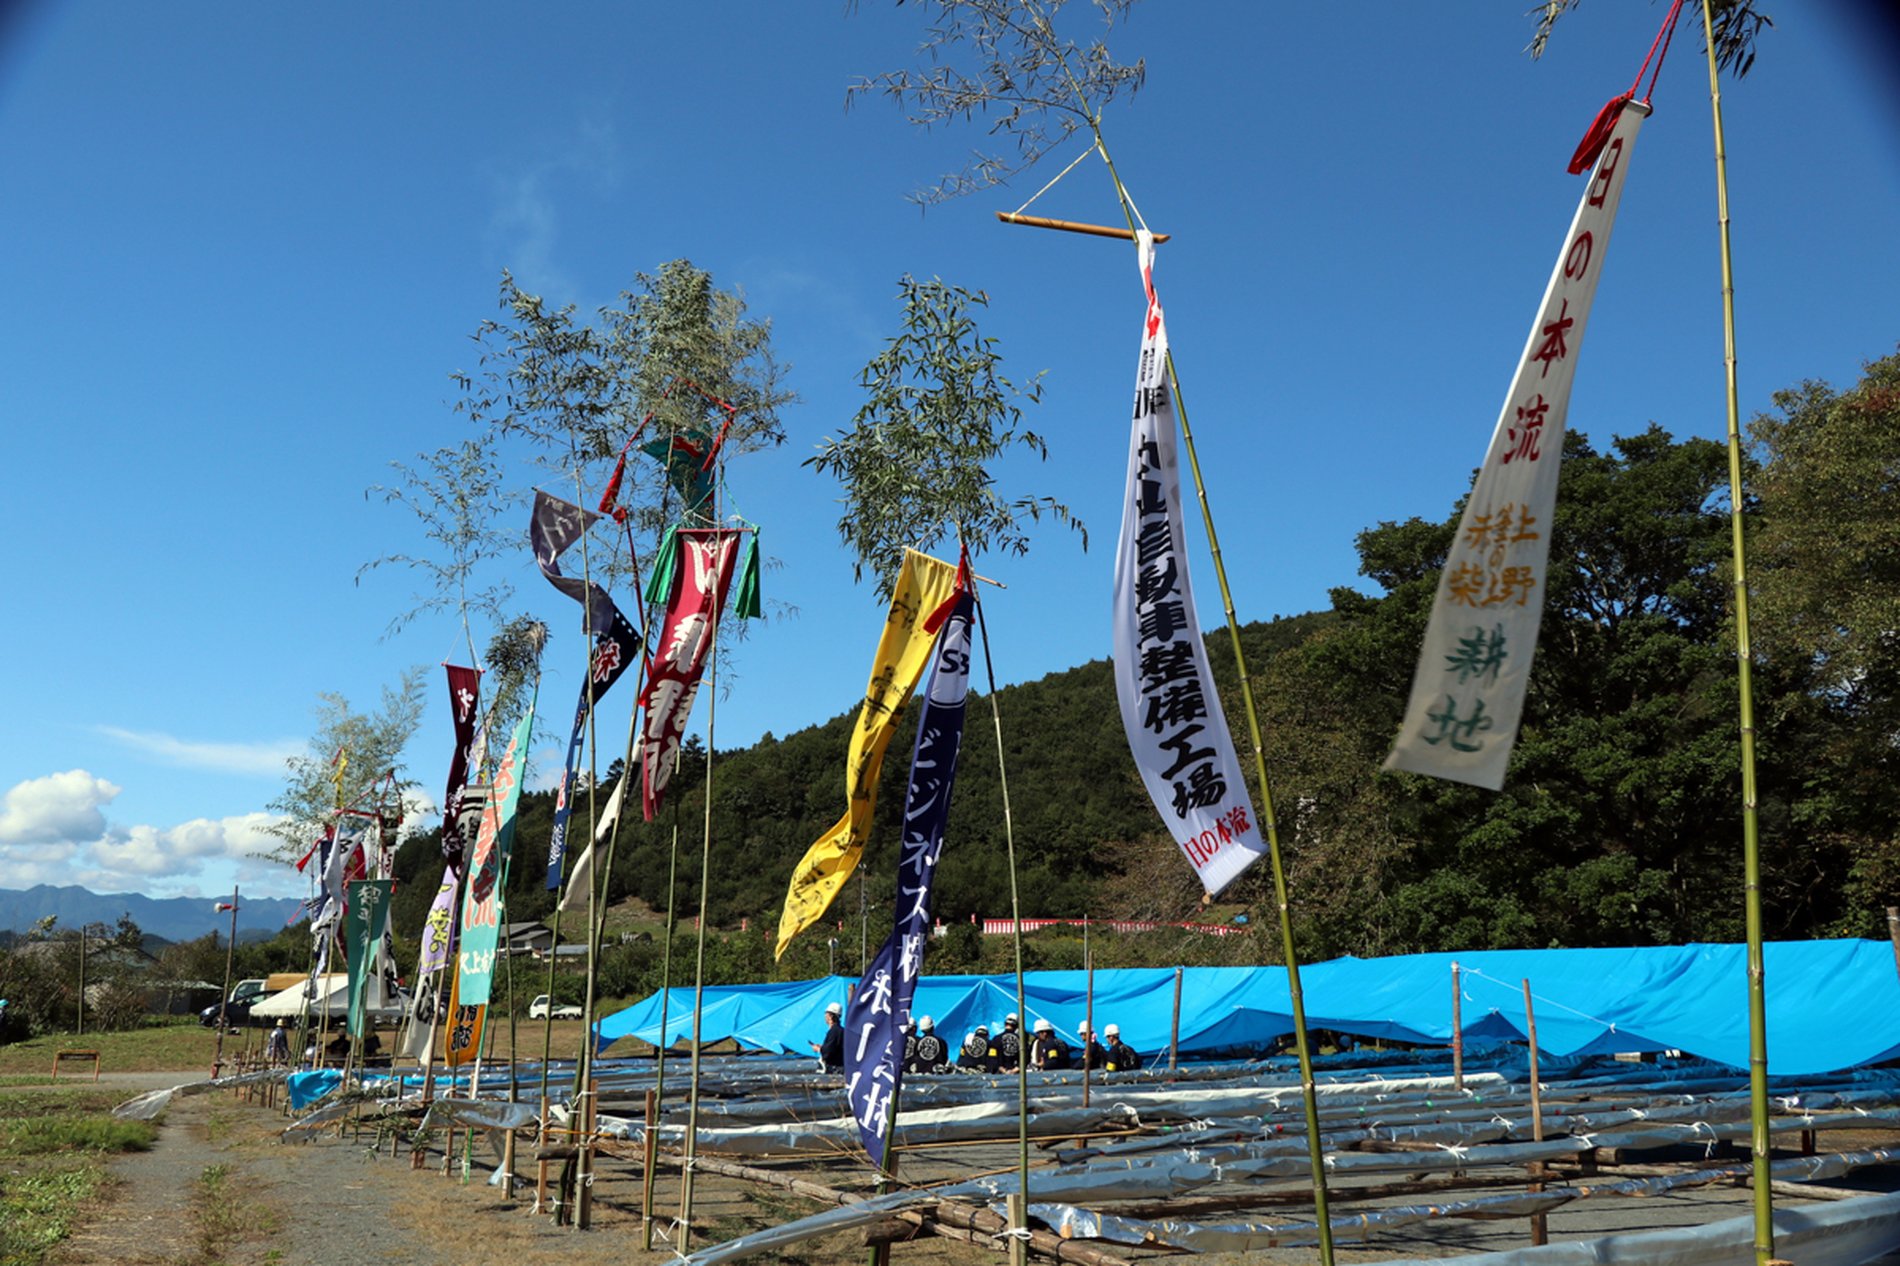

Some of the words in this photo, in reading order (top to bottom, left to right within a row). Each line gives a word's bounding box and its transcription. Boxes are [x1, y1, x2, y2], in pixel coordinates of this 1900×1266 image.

[1502, 136, 1624, 465] 日の本流
[1503, 503, 1541, 608] 上野
[1421, 622, 1509, 753] 耕地
[1183, 805, 1252, 868] 日の本流
